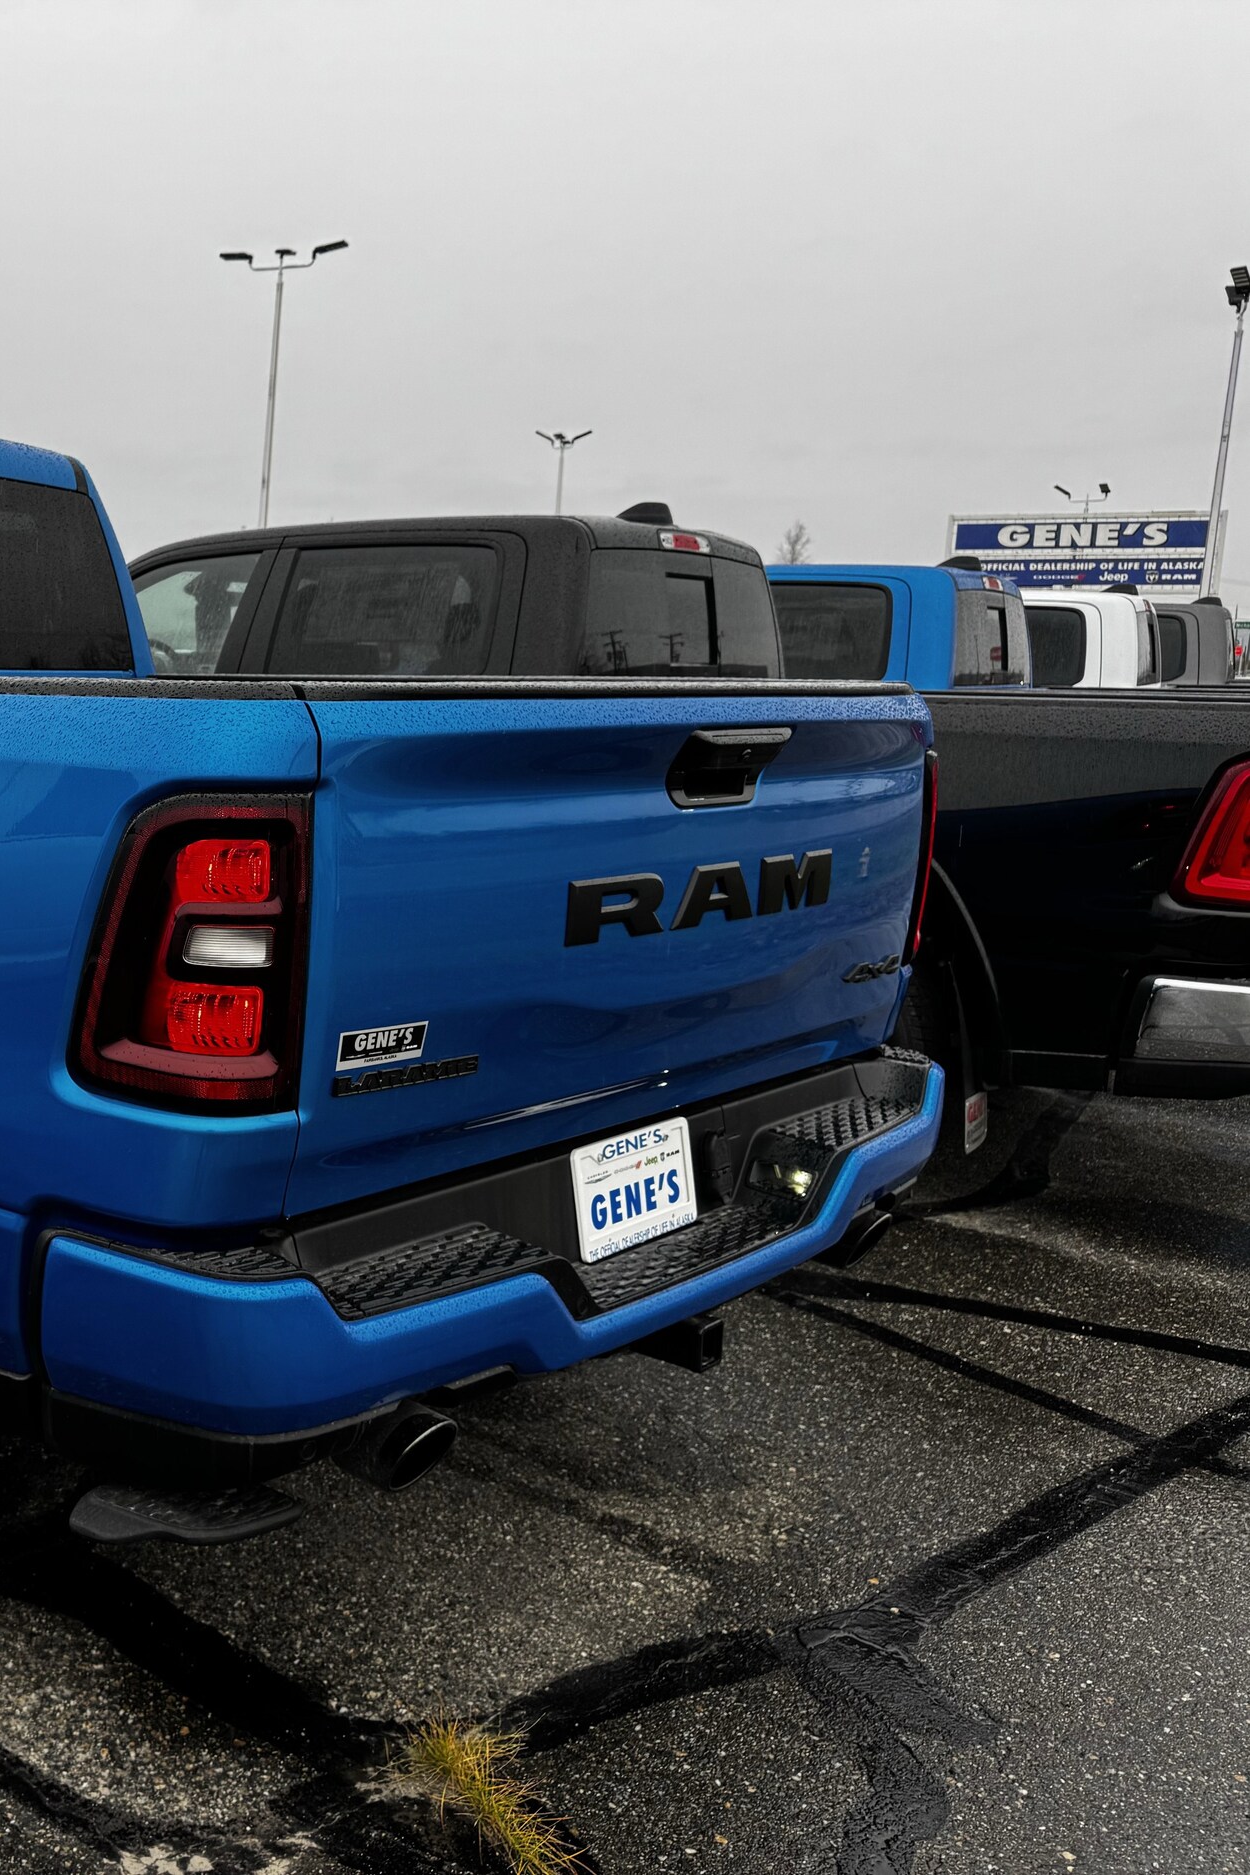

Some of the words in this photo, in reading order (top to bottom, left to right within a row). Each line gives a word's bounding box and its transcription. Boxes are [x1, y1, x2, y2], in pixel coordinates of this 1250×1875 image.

[997, 523, 1168, 548] GENE'S
[981, 562, 1025, 571] OFFICIAL
[1029, 562, 1096, 571] DEALERSHIP
[1100, 562, 1115, 570] OF
[1118, 562, 1140, 570] LIFE
[1143, 562, 1157, 570] IN
[1160, 561, 1204, 570] ALASKA
[1099, 571, 1129, 583] Jeep
[563, 848, 833, 947] RAM
[354, 1027, 415, 1052] GENE'S
[332, 1055, 479, 1097] LARAMIE
[602, 1128, 663, 1160] GENE'S
[644, 1155, 659, 1167] Jeep
[666, 1149, 680, 1158] RAM
[590, 1168, 680, 1230] GENE'S
[589, 1247, 600, 1262] THE
[600, 1240, 621, 1258] OFFICIAL
[621, 1228, 651, 1250] DEALERSHIP
[650, 1224, 659, 1237] OF
[659, 1220, 669, 1234] LIFE
[669, 1218, 676, 1229] IN
[676, 1212, 695, 1226] ALASKA
